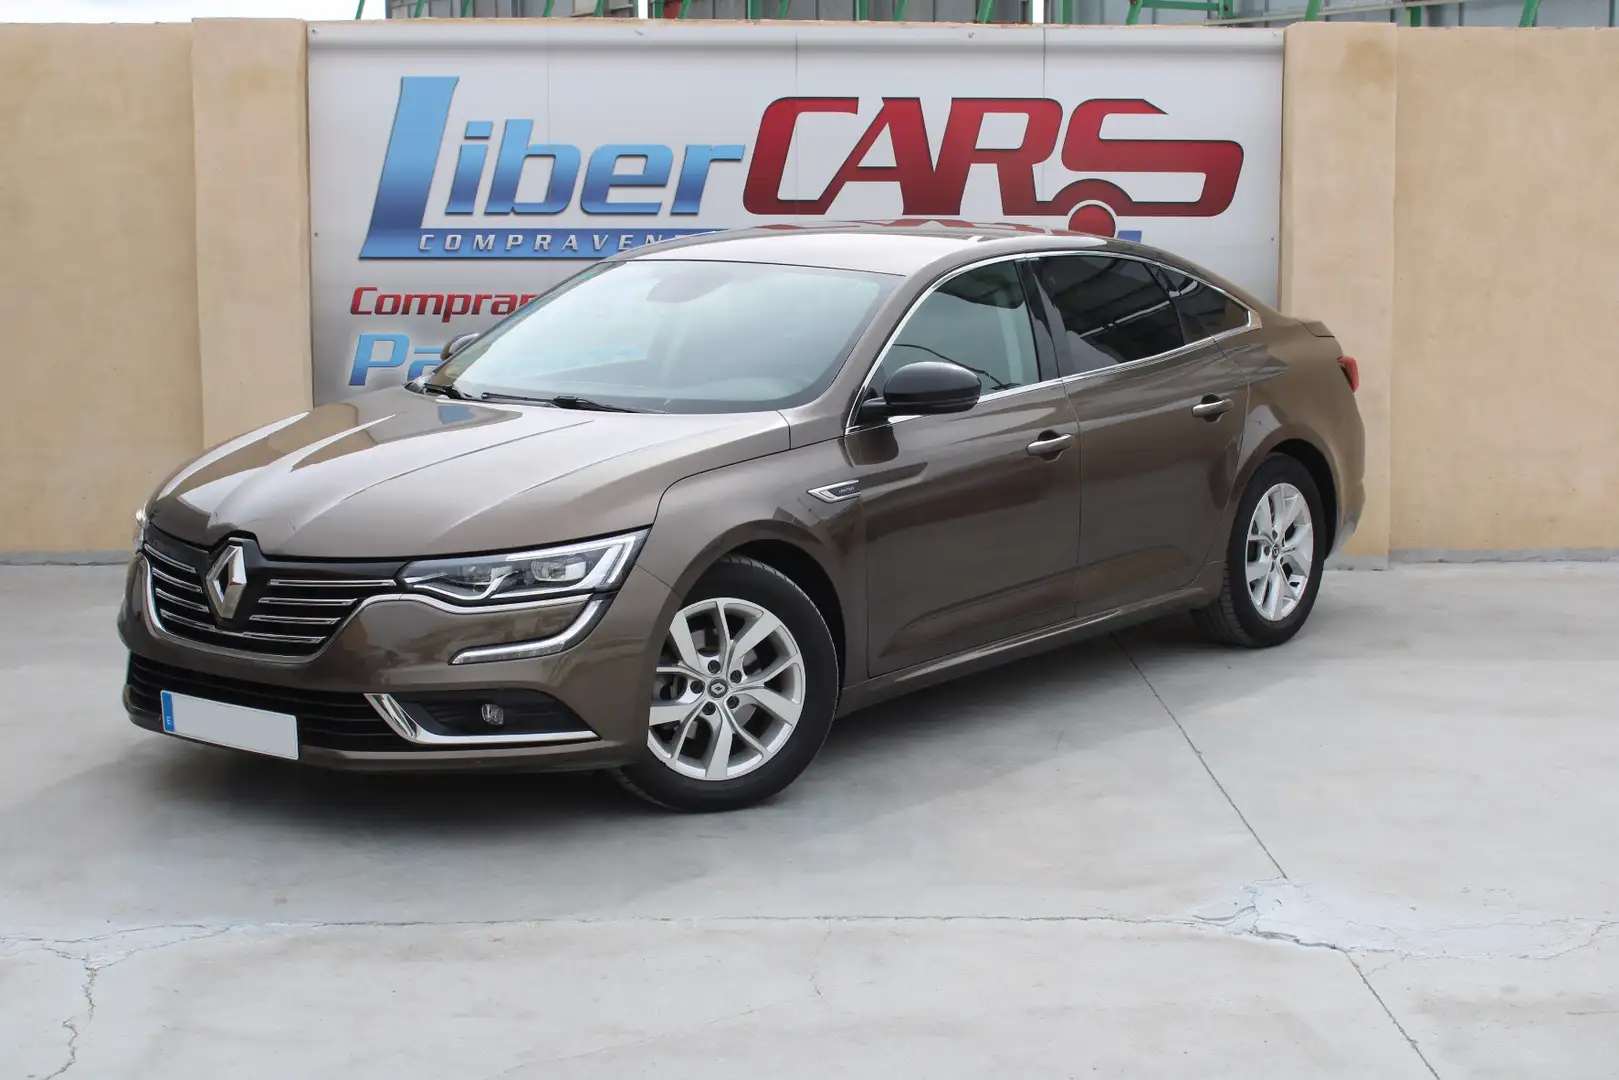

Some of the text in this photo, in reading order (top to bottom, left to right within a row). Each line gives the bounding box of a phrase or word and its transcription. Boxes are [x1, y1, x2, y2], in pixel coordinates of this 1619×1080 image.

[359, 76, 1244, 259] Liber CARS
[419, 234, 691, 251] COMPRAVEN
